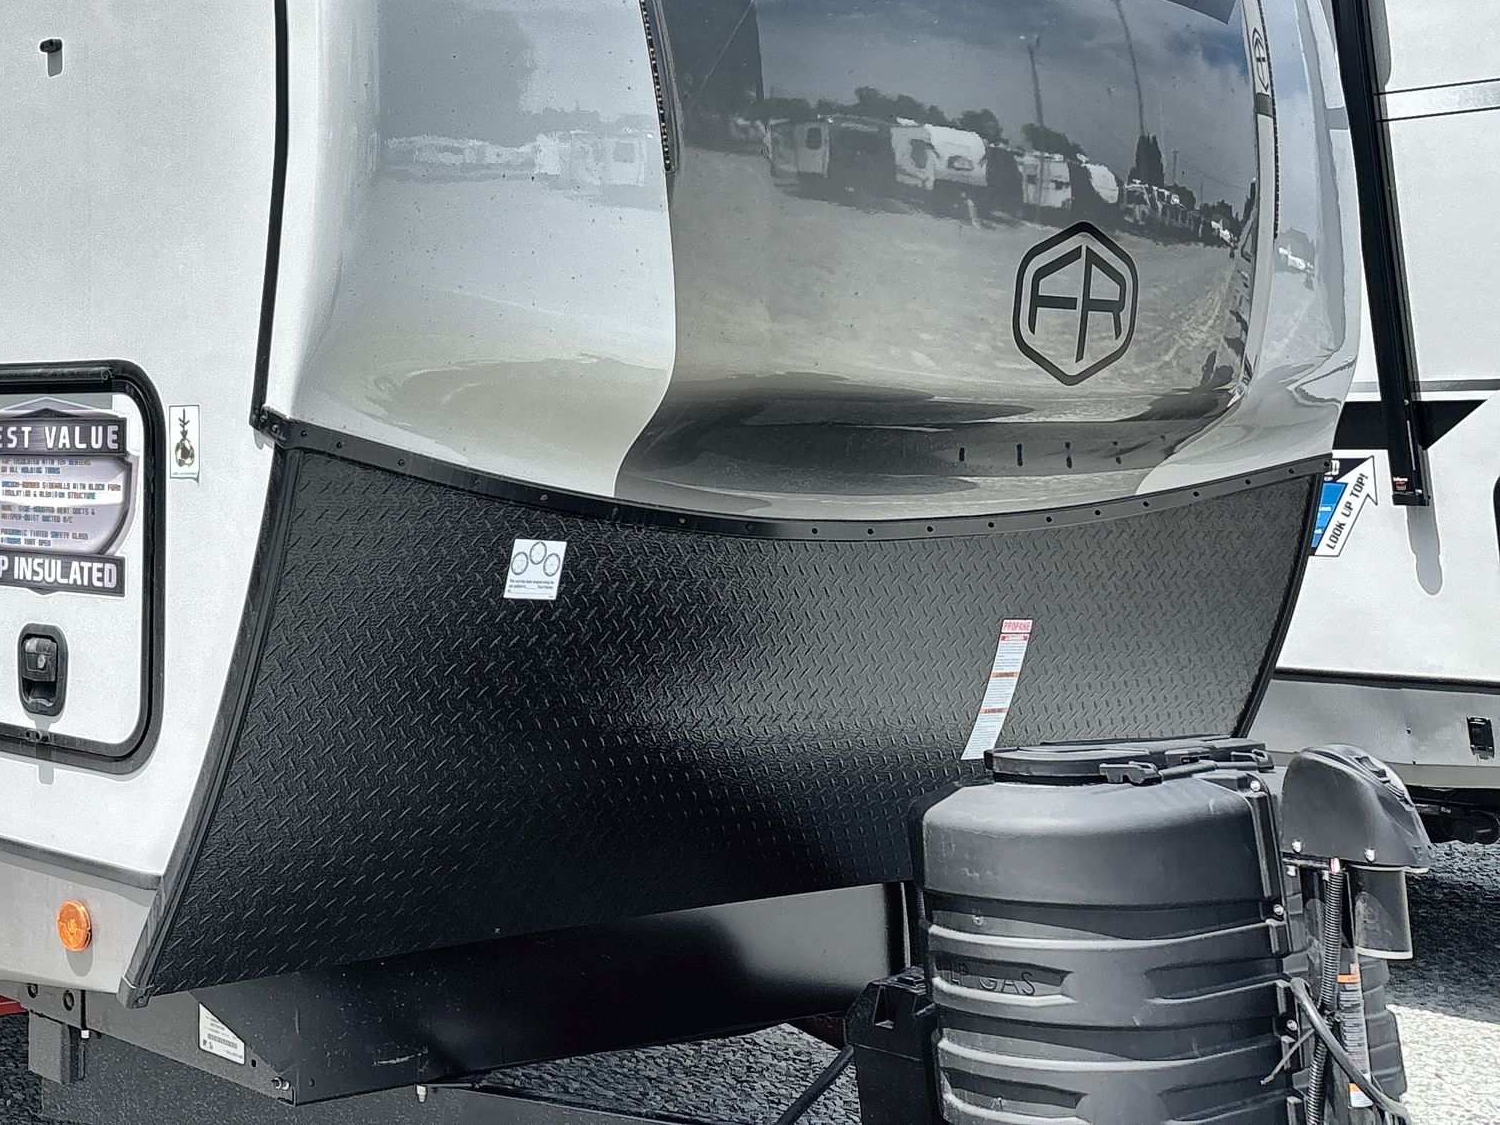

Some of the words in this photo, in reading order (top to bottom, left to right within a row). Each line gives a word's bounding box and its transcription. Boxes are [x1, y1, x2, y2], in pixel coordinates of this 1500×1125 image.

[44, 425, 119, 450] VALUE
[1325, 520, 1346, 550] LOOK
[1341, 501, 1354, 518] UP
[1350, 473, 1368, 498] TOP!
[14, 556, 117, 588] INSULATED
[980, 971, 1035, 996] GAS
